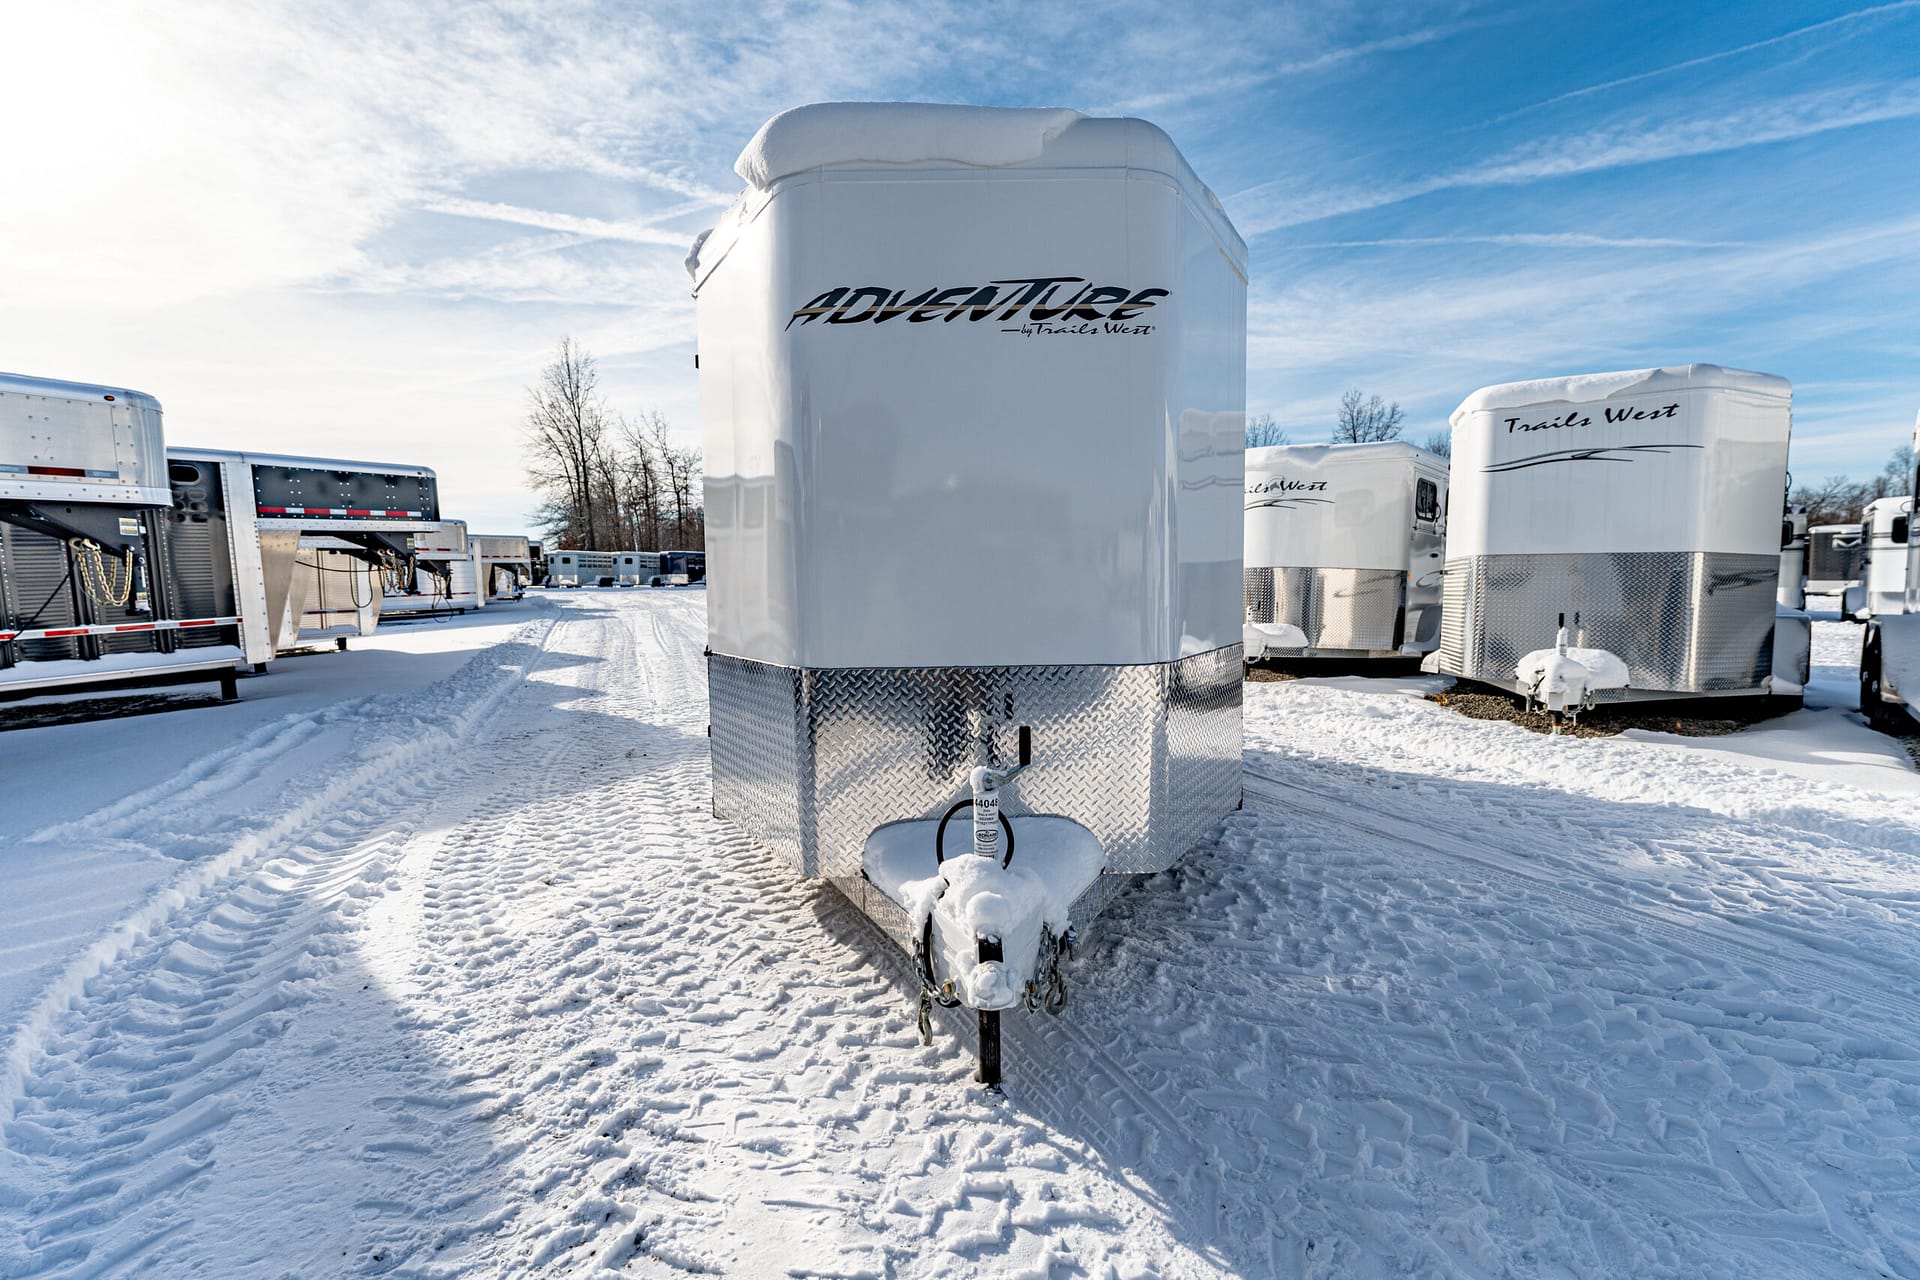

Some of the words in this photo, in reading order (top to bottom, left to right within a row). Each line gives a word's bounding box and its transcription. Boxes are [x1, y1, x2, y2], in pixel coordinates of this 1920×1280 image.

[785, 277, 1171, 332] ADVENTURE
[1021, 324, 1032, 337] by
[1030, 322, 1099, 335] Trails
[1104, 322, 1150, 334] West
[1504, 412, 1592, 433] Trails
[1605, 402, 1680, 423] West
[1279, 479, 1328, 491] West
